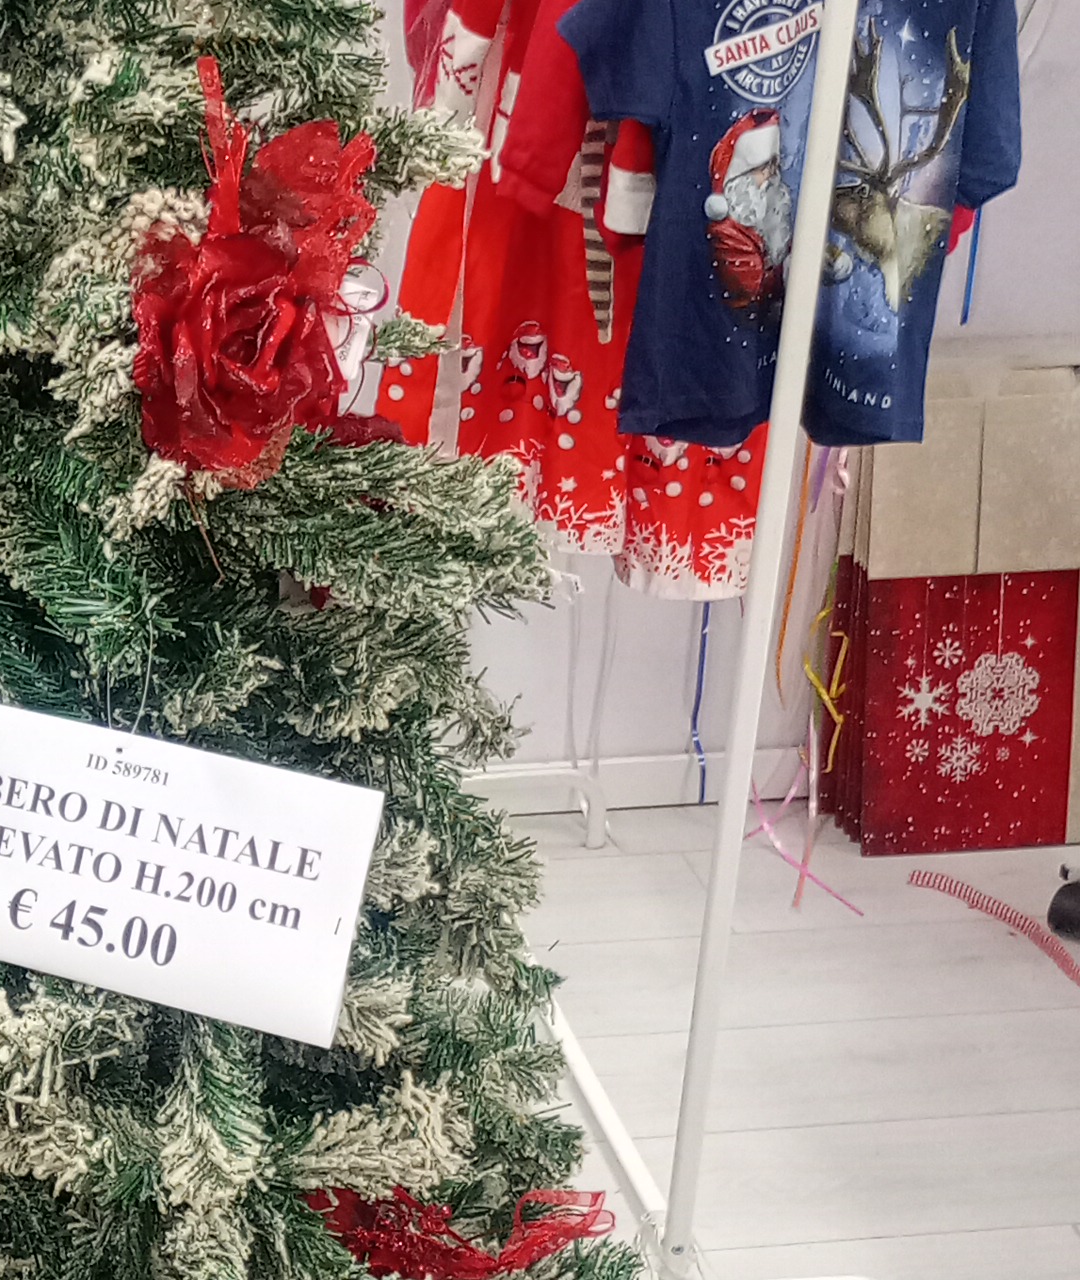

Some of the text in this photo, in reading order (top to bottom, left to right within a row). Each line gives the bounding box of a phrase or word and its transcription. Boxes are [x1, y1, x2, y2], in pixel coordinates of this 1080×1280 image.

[713, 8, 818, 68] SANTA CLAUS
[725, 20, 740, 31] I
[734, 44, 808, 95] ARCTIC CIRCLE
[771, 55, 784, 70] AT
[824, 368, 892, 409] FINLAND
[86, 752, 170, 787] ID 589781
[96, 801, 145, 838] DI
[151, 811, 322, 882] NATALE
[131, 859, 238, 913] H.200
[248, 896, 302, 932] cm
[7, 887, 178, 967] € 45.00
